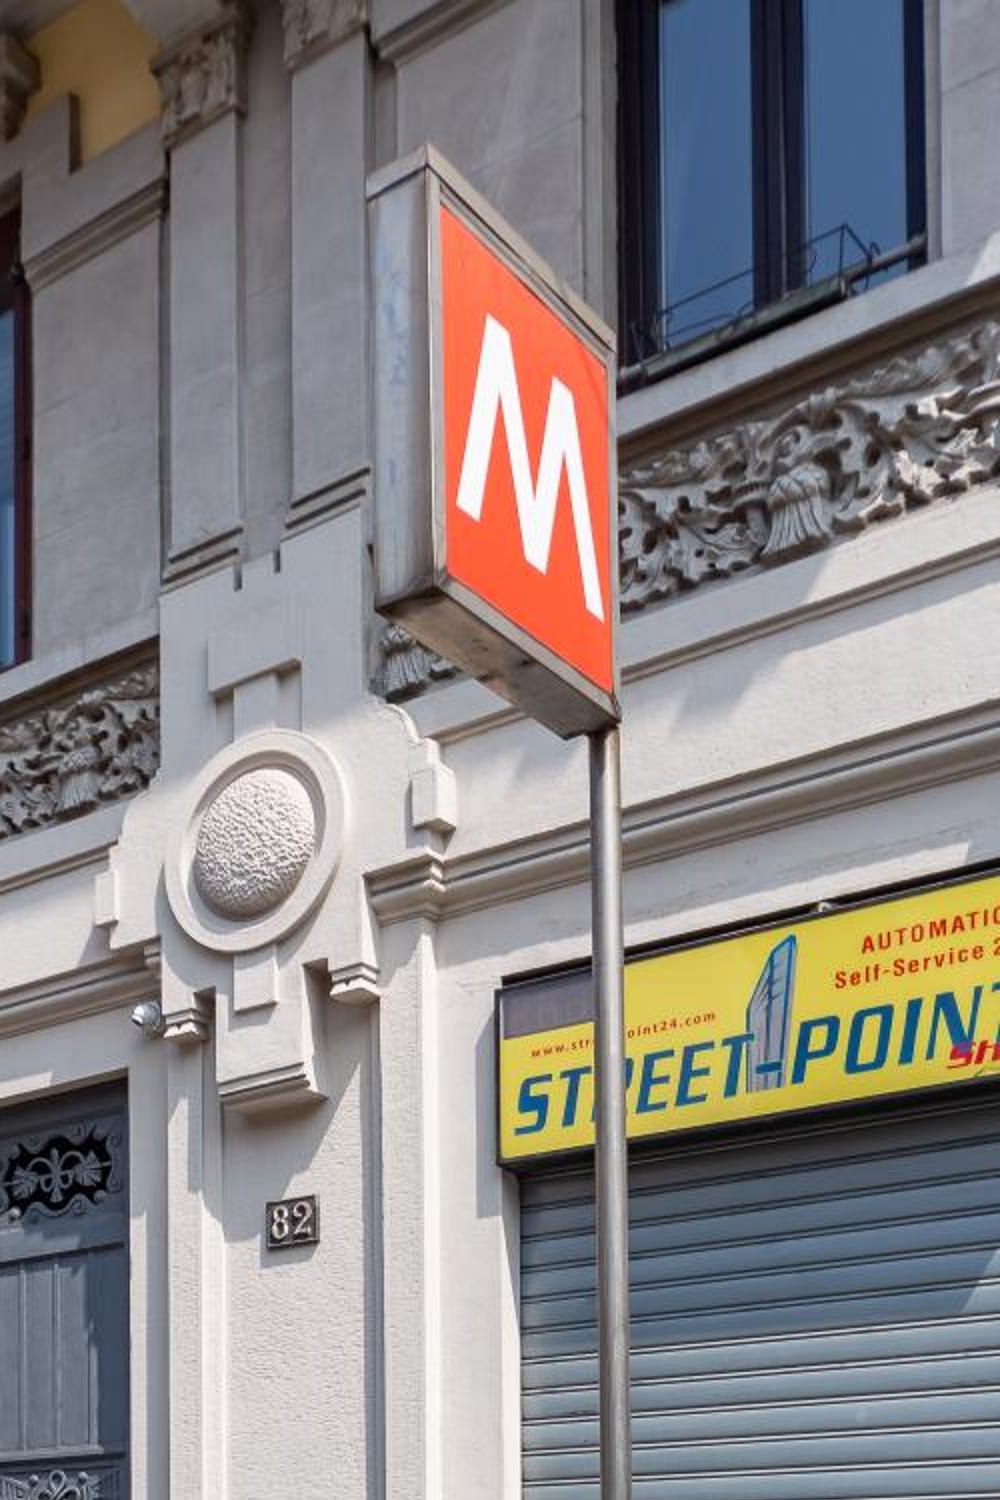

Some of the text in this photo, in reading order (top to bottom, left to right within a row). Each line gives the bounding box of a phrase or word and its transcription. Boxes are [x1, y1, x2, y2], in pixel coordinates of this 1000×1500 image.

[456, 312, 606, 624] M
[834, 943, 985, 990] Self-Service
[271, 1201, 312, 1239] 82
